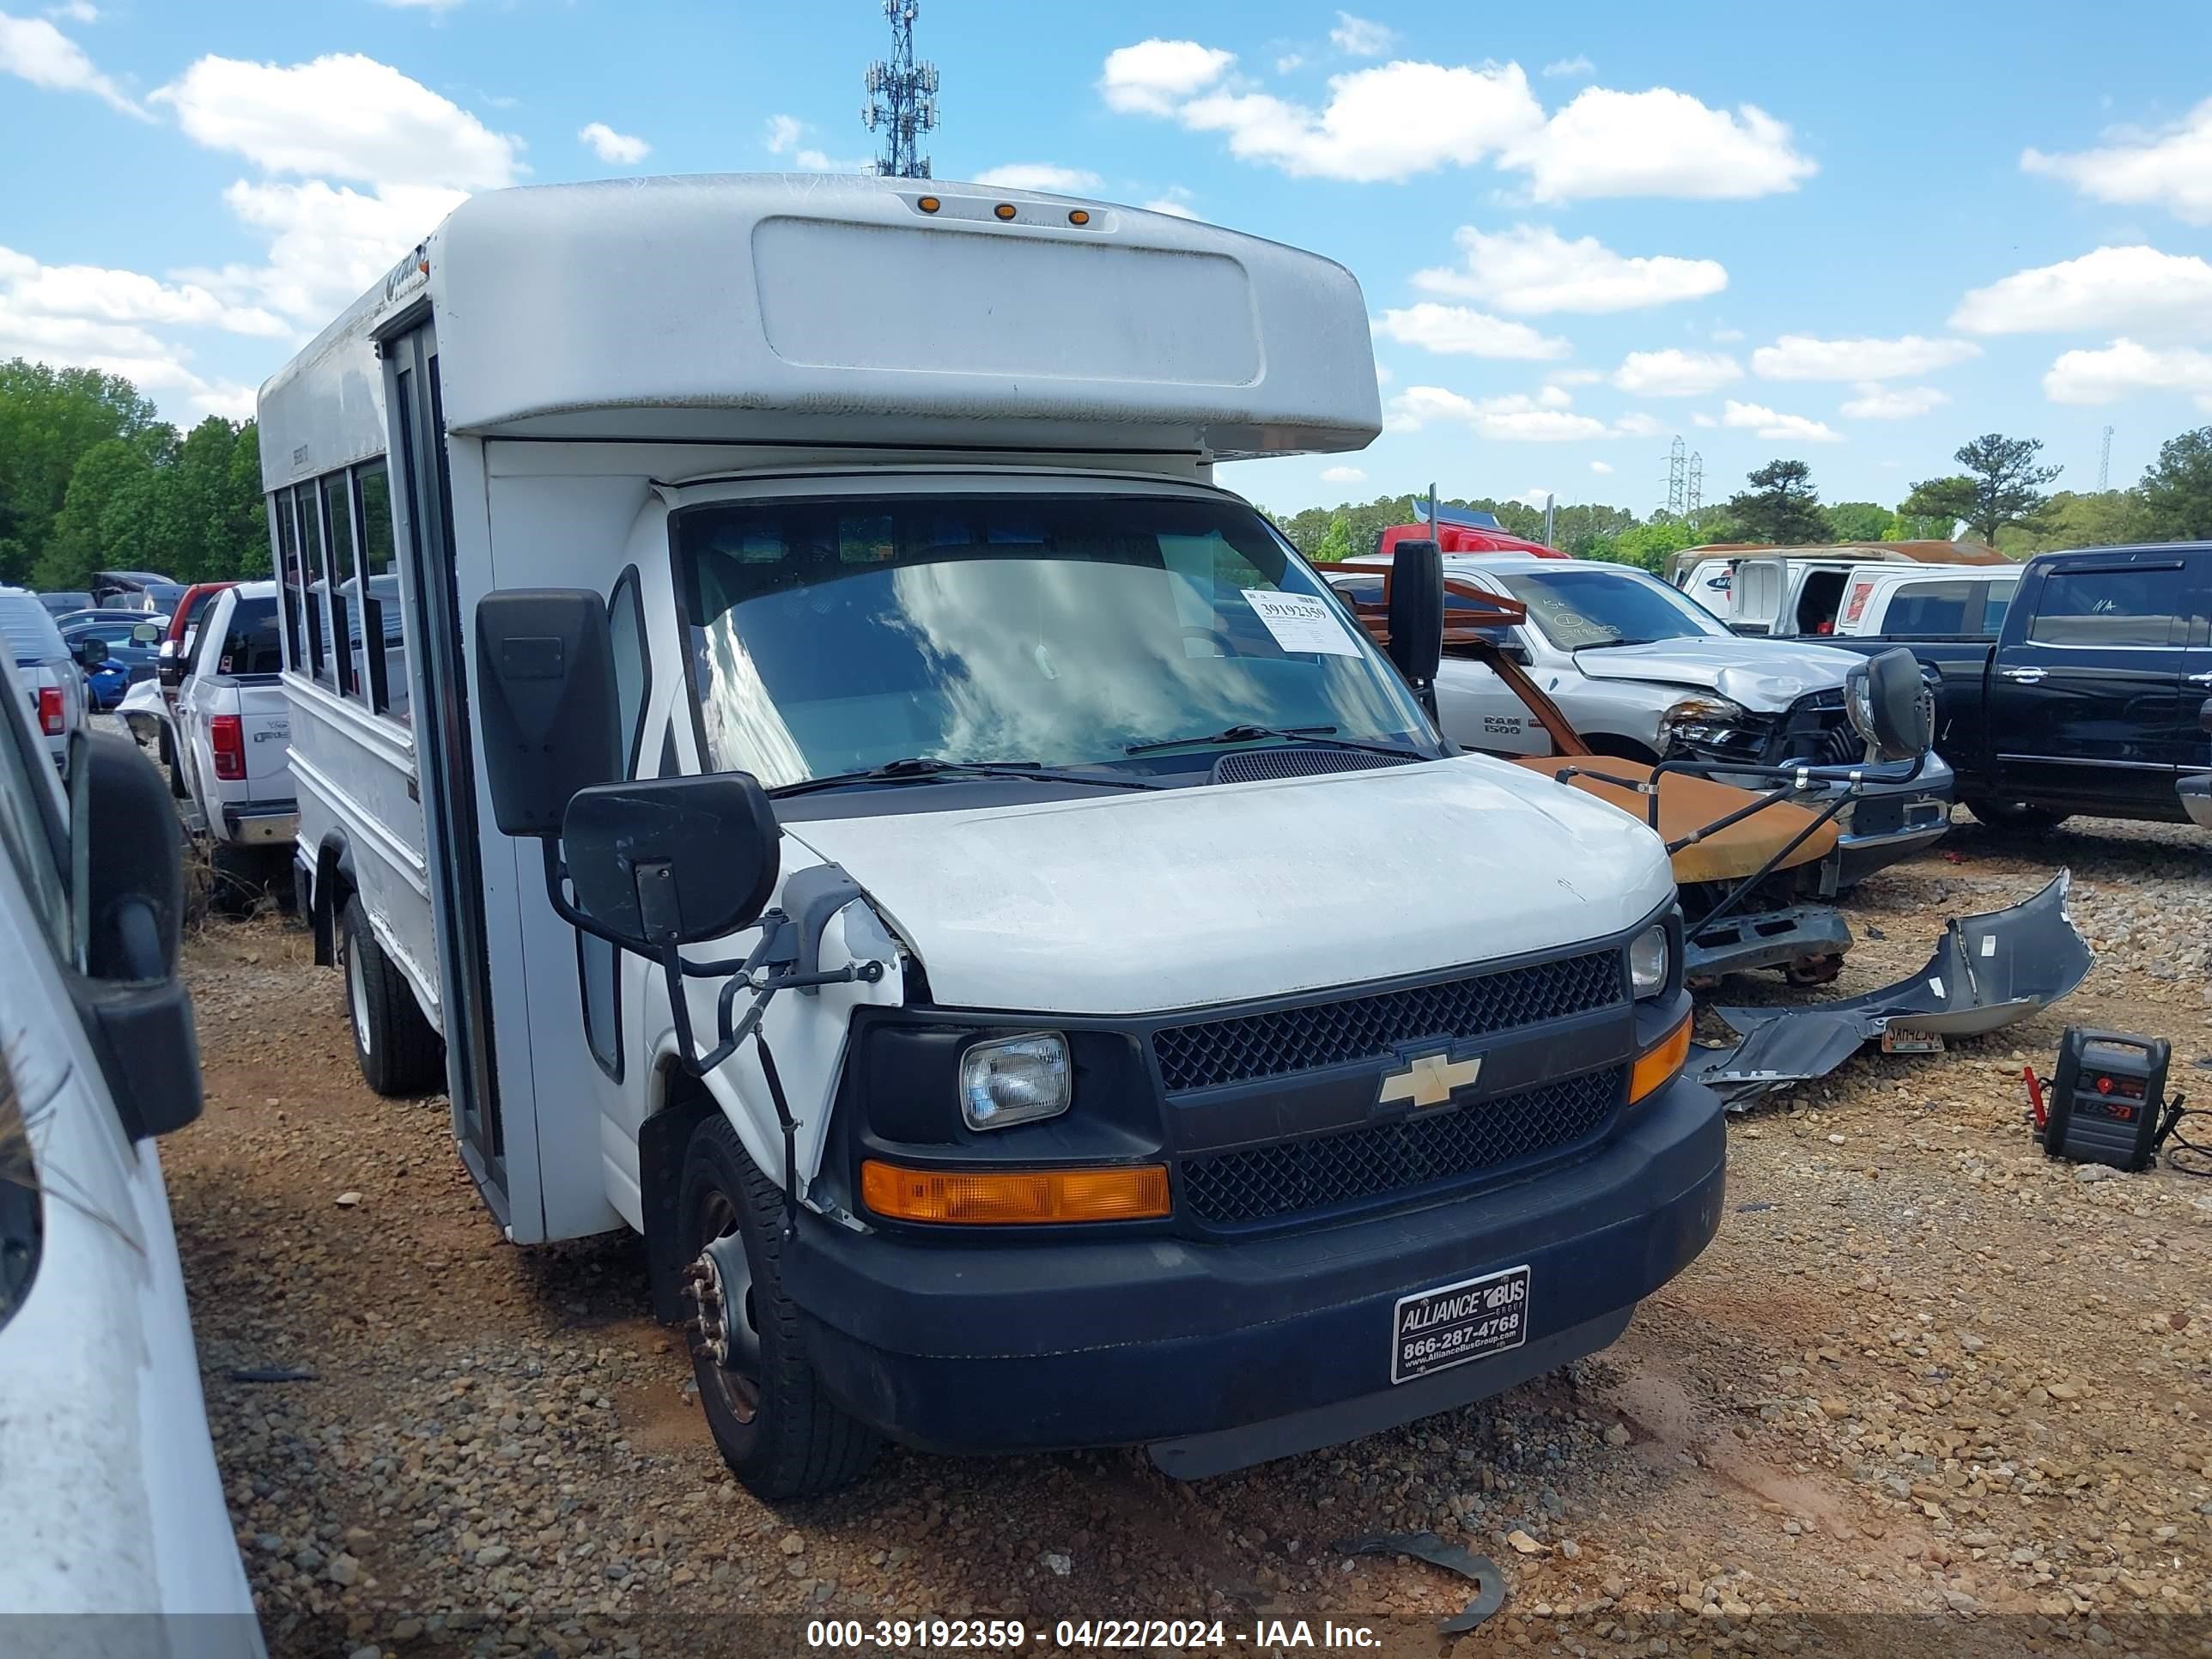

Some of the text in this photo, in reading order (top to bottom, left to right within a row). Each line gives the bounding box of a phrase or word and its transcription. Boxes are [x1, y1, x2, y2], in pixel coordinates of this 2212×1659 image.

[1261, 603, 1327, 619] 39192359
[1484, 714, 1522, 726] RAM
[1484, 724, 1522, 735] 1500
[1401, 1279, 1525, 1334] ALLIANCE BUS
[1496, 1301, 1524, 1316] GROUP
[1403, 1313, 1519, 1360] 866-287-4768
[1405, 1330, 1517, 1369] www.AllianceBusGroup.com
